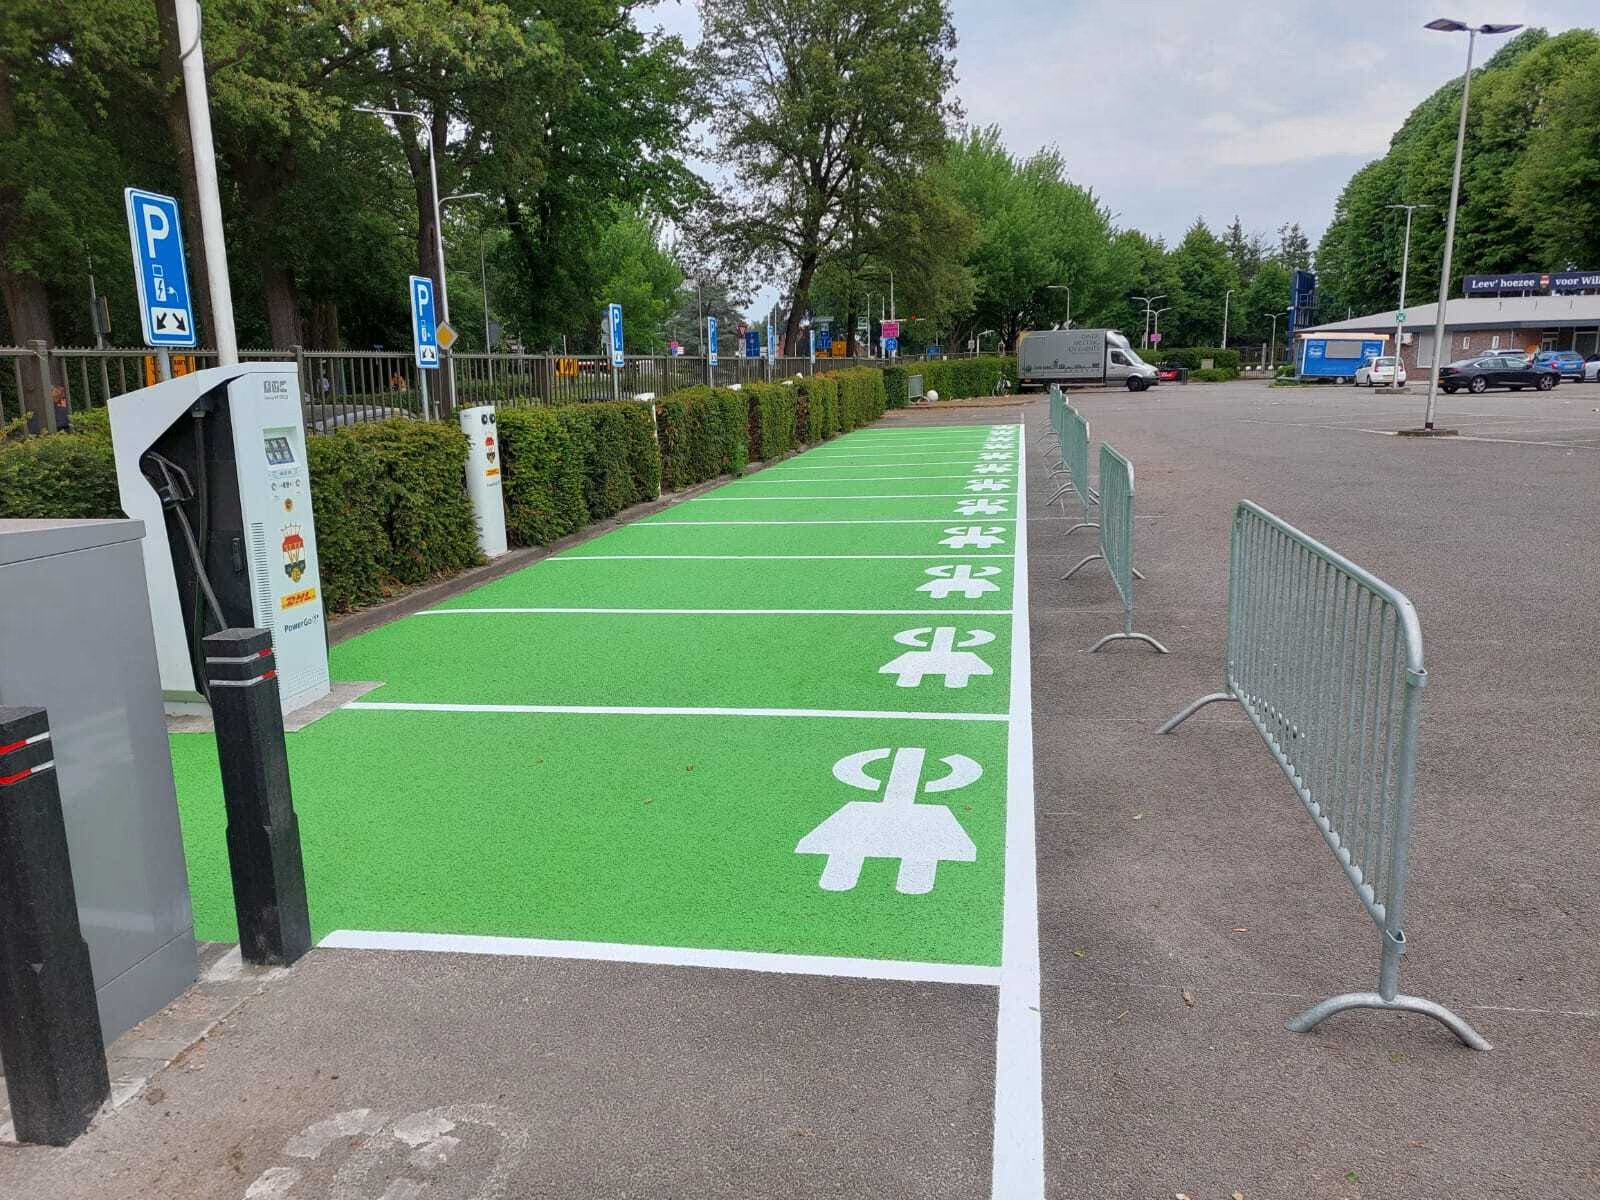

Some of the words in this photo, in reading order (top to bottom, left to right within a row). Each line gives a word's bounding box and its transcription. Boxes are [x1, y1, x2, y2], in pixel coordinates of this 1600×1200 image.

[142, 203, 170, 259] P
[1472, 279, 1498, 288] Leev'
[1500, 279, 1535, 288] hoezee
[1555, 278, 1579, 286] voor
[417, 284, 429, 317] P
[613, 309, 620, 331] P
